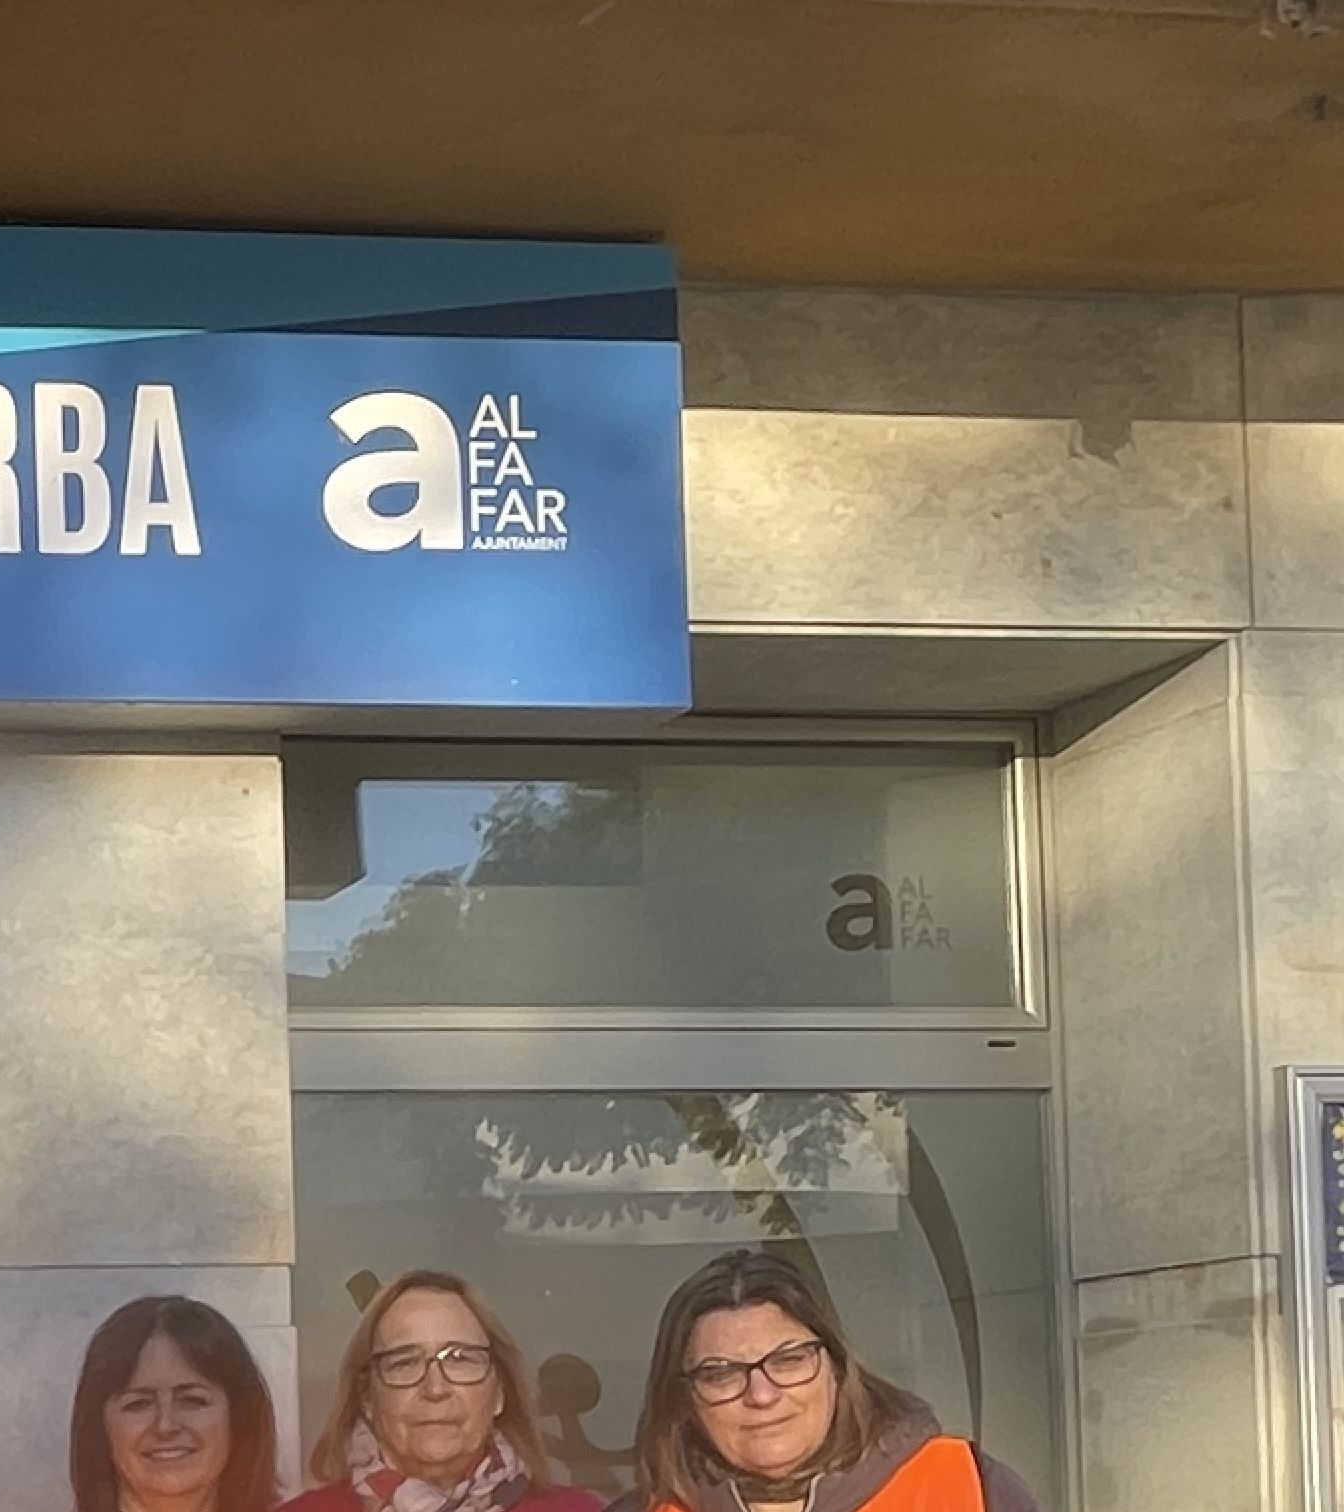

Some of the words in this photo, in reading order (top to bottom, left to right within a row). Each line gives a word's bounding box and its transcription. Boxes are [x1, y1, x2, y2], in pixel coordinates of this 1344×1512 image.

[468, 394, 537, 440] AL
[323, 391, 464, 551] a
[468, 440, 524, 486] FA
[469, 488, 568, 534] FAR
[471, 536, 568, 551] AJUNTAMENT
[898, 876, 933, 900] AL
[826, 874, 893, 952] a
[899, 900, 934, 925] FA
[899, 926, 953, 951] FAR
